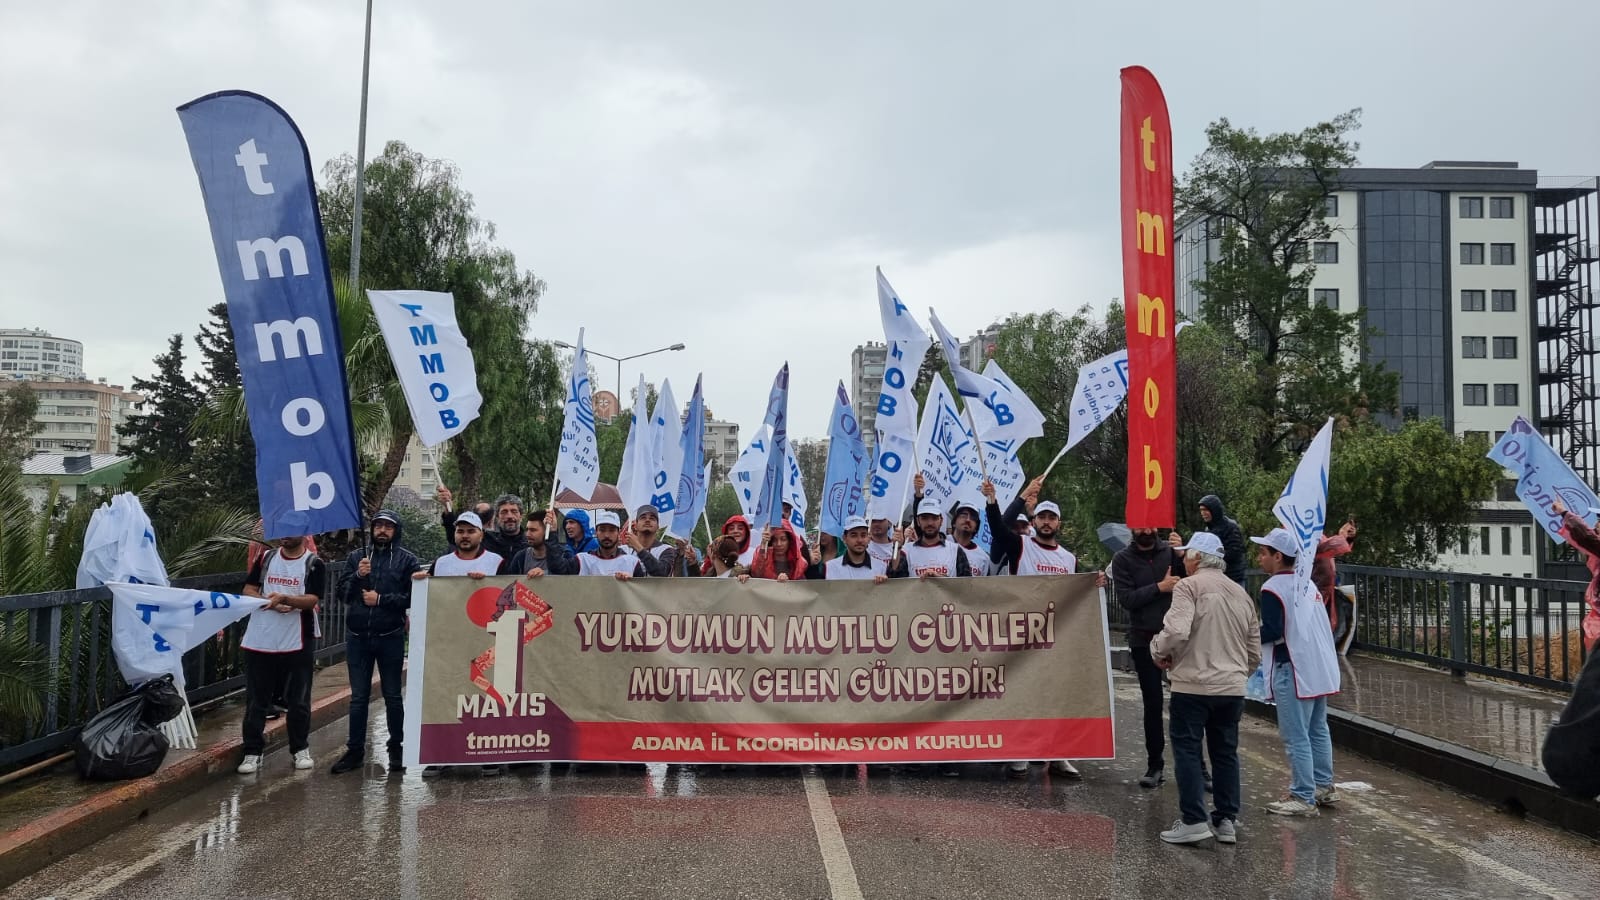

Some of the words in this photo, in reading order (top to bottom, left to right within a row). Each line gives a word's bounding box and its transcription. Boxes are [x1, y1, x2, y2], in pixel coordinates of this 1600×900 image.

[235, 138, 335, 512] tmmob
[1136, 116, 1166, 500] tmmob
[399, 303, 460, 429] TMMOB
[576, 612, 776, 653] YURDUMUN
[785, 614, 899, 653] MUTLU
[908, 602, 1056, 652] GÜNLERİ
[630, 666, 746, 702] MUTLAK
[751, 667, 840, 701] GELEN
[849, 659, 1006, 701] GÜNDEDİR!
[456, 692, 546, 718] MAYIS
[466, 729, 551, 750] tmmob
[631, 736, 705, 752] ADANA
[711, 732, 730, 752] İL
[736, 732, 908, 752] KOORDİNASYON
[915, 734, 1003, 750] KURULU
